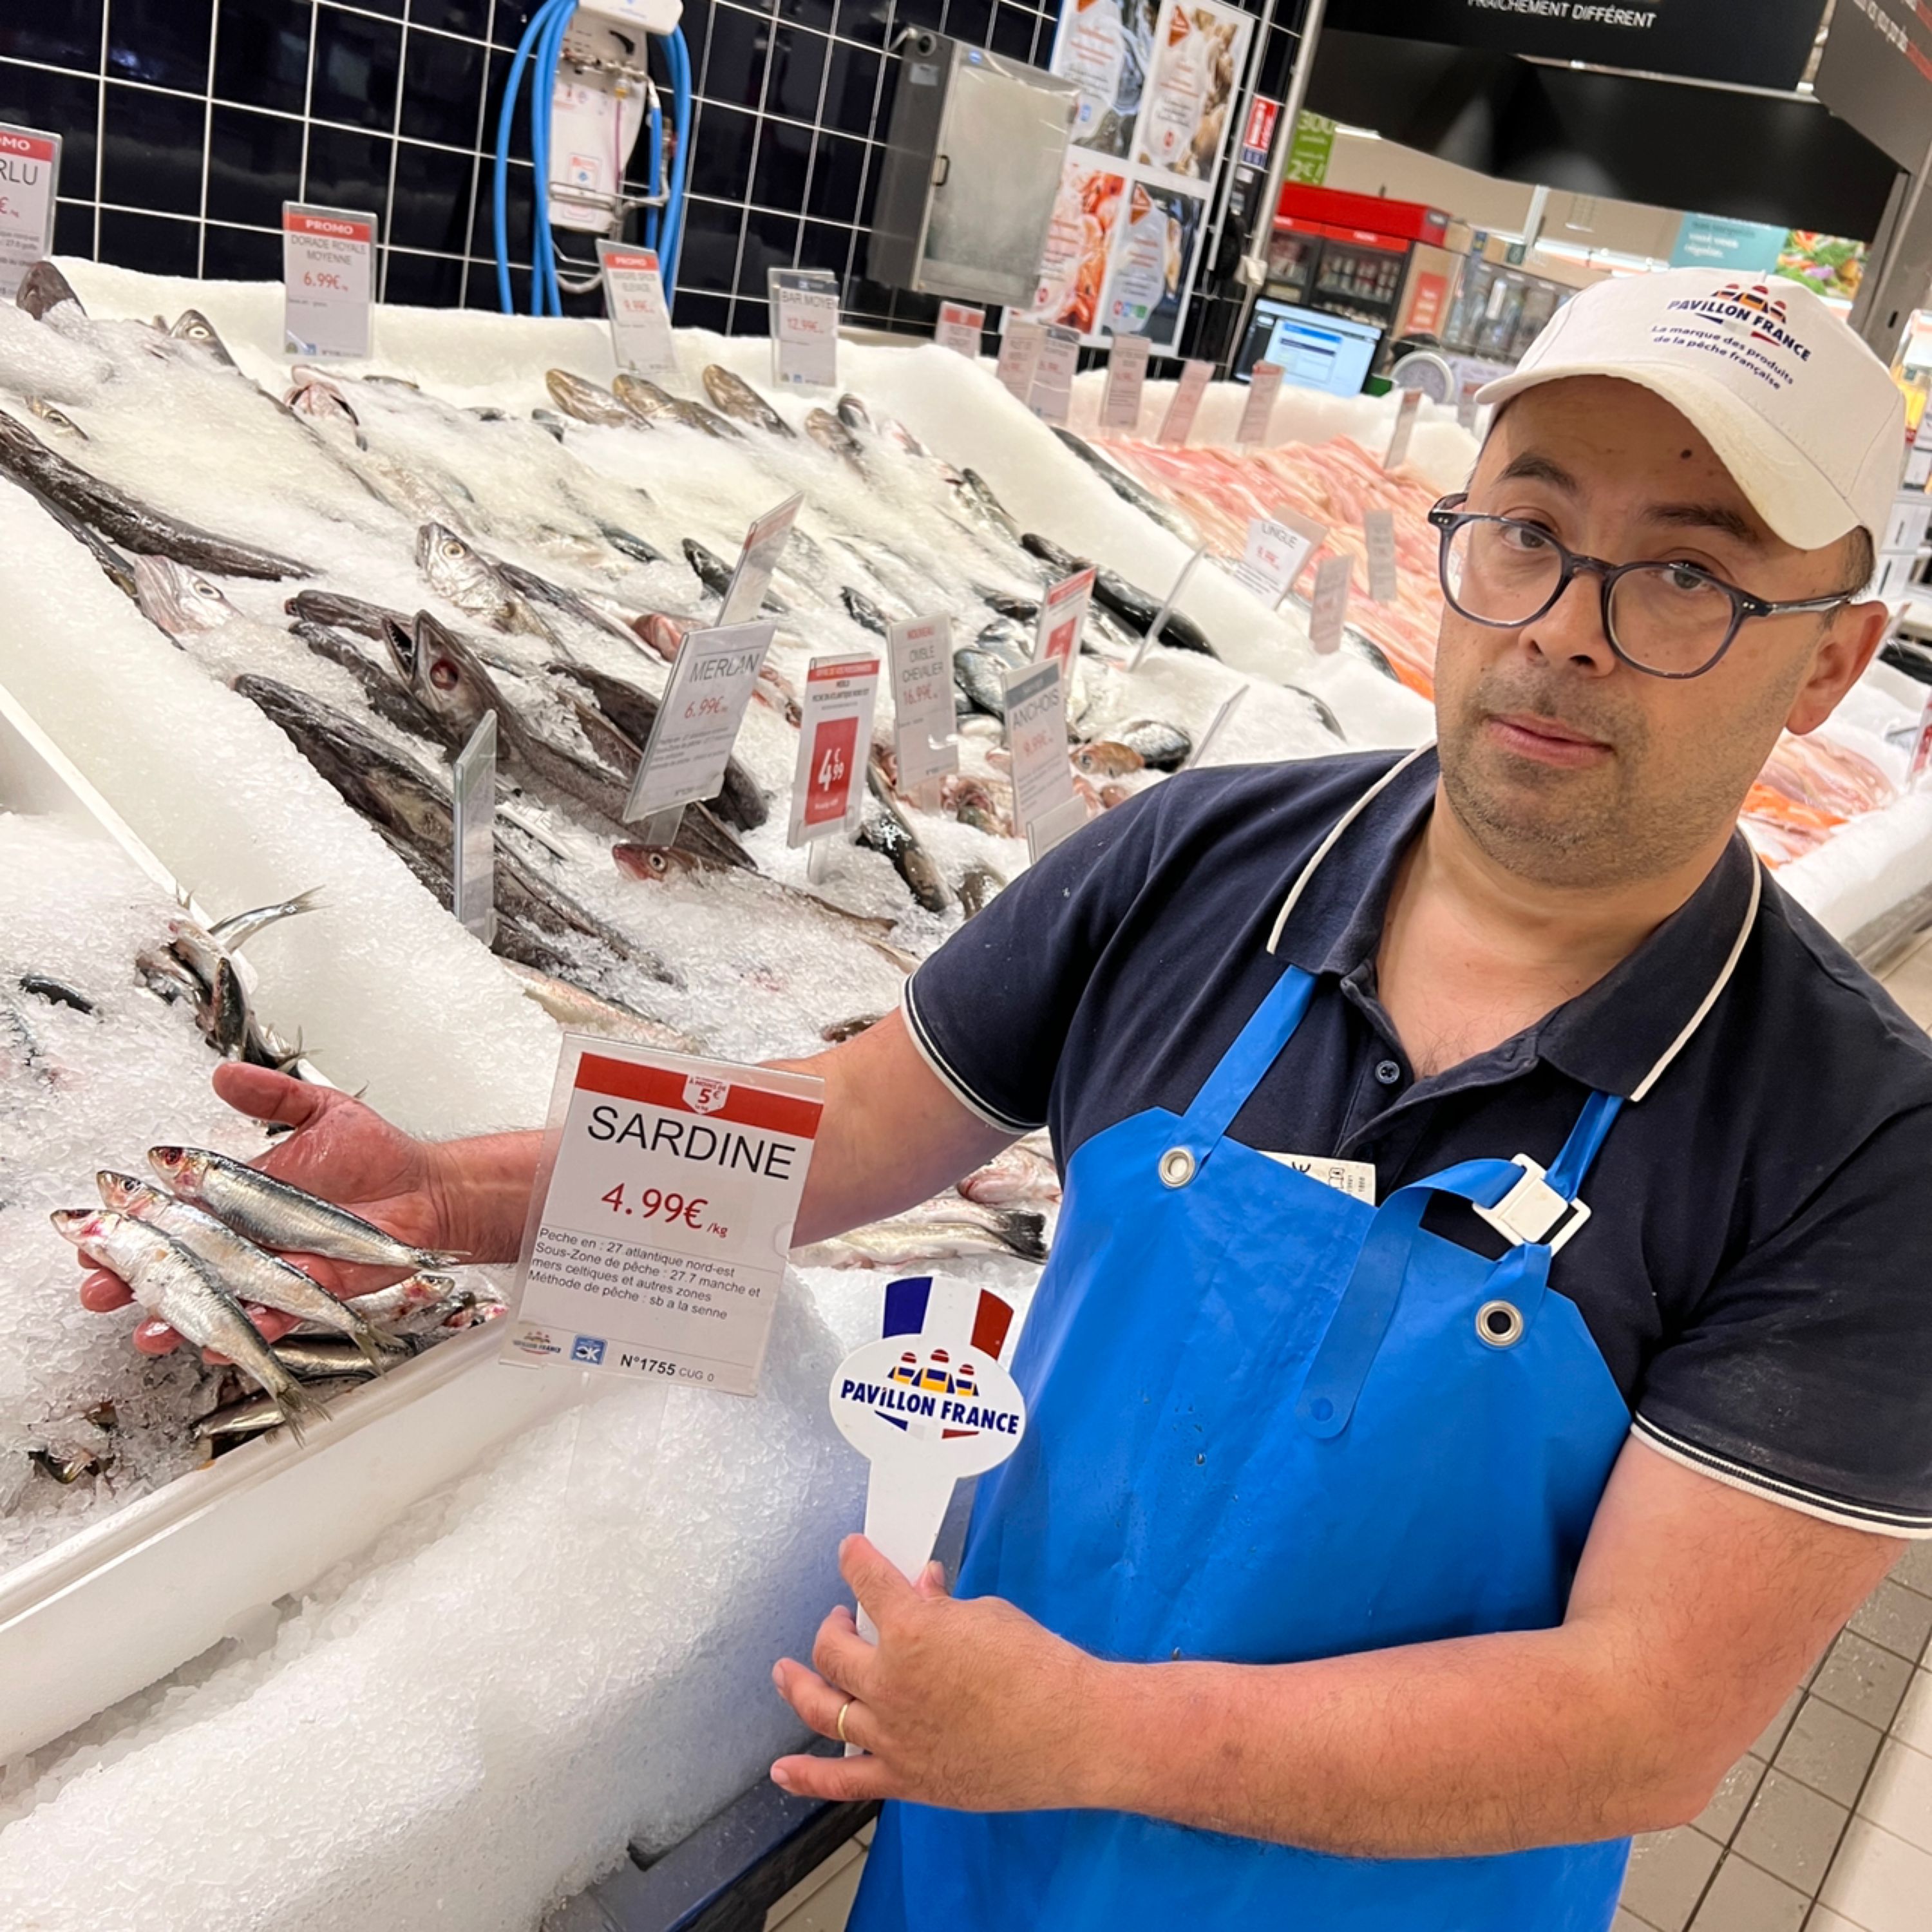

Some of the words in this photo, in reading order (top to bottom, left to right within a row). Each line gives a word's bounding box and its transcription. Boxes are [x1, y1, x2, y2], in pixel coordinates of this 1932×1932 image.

[1571, 5, 1656, 28] DIFFÉRENT
[291, 234, 330, 250] DORADE
[332, 240, 367, 255] ROYALE
[305, 219, 354, 235] PROMO
[307, 249, 352, 266] MOYENNE
[303, 270, 341, 290] 6.99€
[1651, 325, 1667, 333] La
[1669, 327, 1721, 341] marque
[1723, 336, 1745, 351] des
[1746, 348, 1794, 385] produits
[1752, 314, 1812, 362] FRANCE
[1653, 335, 1670, 343] de
[1672, 336, 1685, 345] la
[1686, 340, 1727, 355] pêche
[1729, 351, 1781, 390] française
[688, 653, 761, 683] MERLAN
[684, 696, 724, 719] 6.99€
[1013, 688, 1059, 730] ANCHOIS
[587, 1105, 797, 1180] SARDINE
[601, 1182, 709, 1229] 4.99€
[706, 1222, 728, 1238] /kg
[536, 1242, 602, 1265] Sous-Zone
[604, 1257, 621, 1269] de
[622, 1260, 661, 1278] pêche
[669, 1269, 697, 1284] 27.7
[698, 1277, 746, 1296] manche
[748, 1286, 761, 1298] et
[540, 1227, 578, 1245] Peche
[581, 1238, 597, 1249] en
[606, 1241, 624, 1255] 27
[625, 1247, 684, 1269] atlantique
[685, 1258, 735, 1278] nord-est
[527, 1269, 582, 1290] Méthode
[583, 1281, 600, 1294] de
[601, 1285, 640, 1303] pêche
[649, 1294, 665, 1307] sb
[666, 1300, 676, 1309] a
[677, 1299, 689, 1312] la
[690, 1305, 728, 1320] senne
[531, 1257, 563, 1271] mers
[565, 1263, 619, 1285] celtiques
[621, 1274, 634, 1287] et
[636, 1278, 674, 1295] autres
[675, 1288, 712, 1303] zones
[620, 1354, 677, 1376] N°1755
[678, 1367, 704, 1381] CUG
[940, 1399, 1019, 1435] FRANCE
